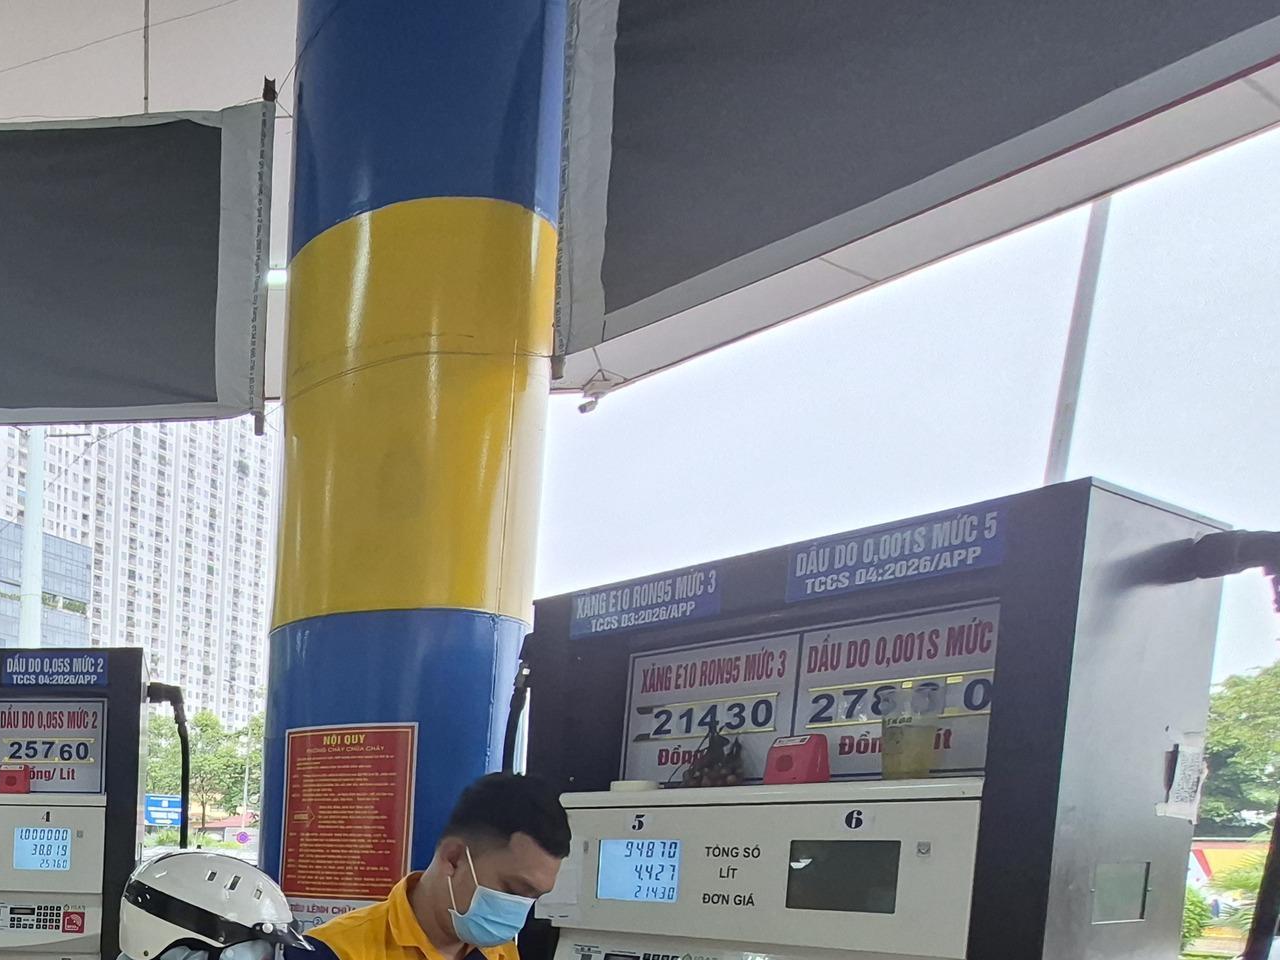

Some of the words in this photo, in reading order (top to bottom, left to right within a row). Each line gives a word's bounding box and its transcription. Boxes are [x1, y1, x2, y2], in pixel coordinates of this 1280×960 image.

[834, 542, 857, 569] DO
[862, 526, 926, 564] 0,001S
[931, 513, 978, 549] MỨC
[984, 512, 998, 539] 5
[609, 588, 630, 612] E10
[633, 579, 672, 608] RON95
[708, 570, 716, 593] 3
[806, 572, 849, 594] TCCS
[590, 616, 618, 632] TCCS
[846, 639, 870, 669] DO
[875, 629, 939, 668] 0,001S
[946, 617, 993, 657] MỨC
[28, 658, 41, 673] DO
[43, 658, 70, 674] 0,05S
[97, 658, 103, 673] 2
[675, 663, 697, 689] E10
[699, 656, 740, 687] RON95
[744, 647, 773, 682] MỨC
[777, 650, 786, 678] 3
[12, 674, 36, 684] TCCS
[22, 711, 34, 729] DO
[38, 711, 64, 731] 0,05S
[67, 707, 88, 729] MỨC
[91, 711, 97, 729] 2
[652, 699, 773, 735] 21430
[323, 734, 340, 746] NỘI
[344, 734, 365, 745] QUY
[8, 741, 89, 761] 25760
[60, 768, 75, 780] Lít
[632, 814, 645, 831] 5
[845, 809, 863, 829] 6
[625, 841, 678, 858] 94870
[743, 844, 761, 858] SỐ
[719, 865, 738, 879] LÍT
[634, 885, 675, 900] 21430
[702, 892, 729, 905] ĐƠN
[733, 893, 755, 906] GIÁ
